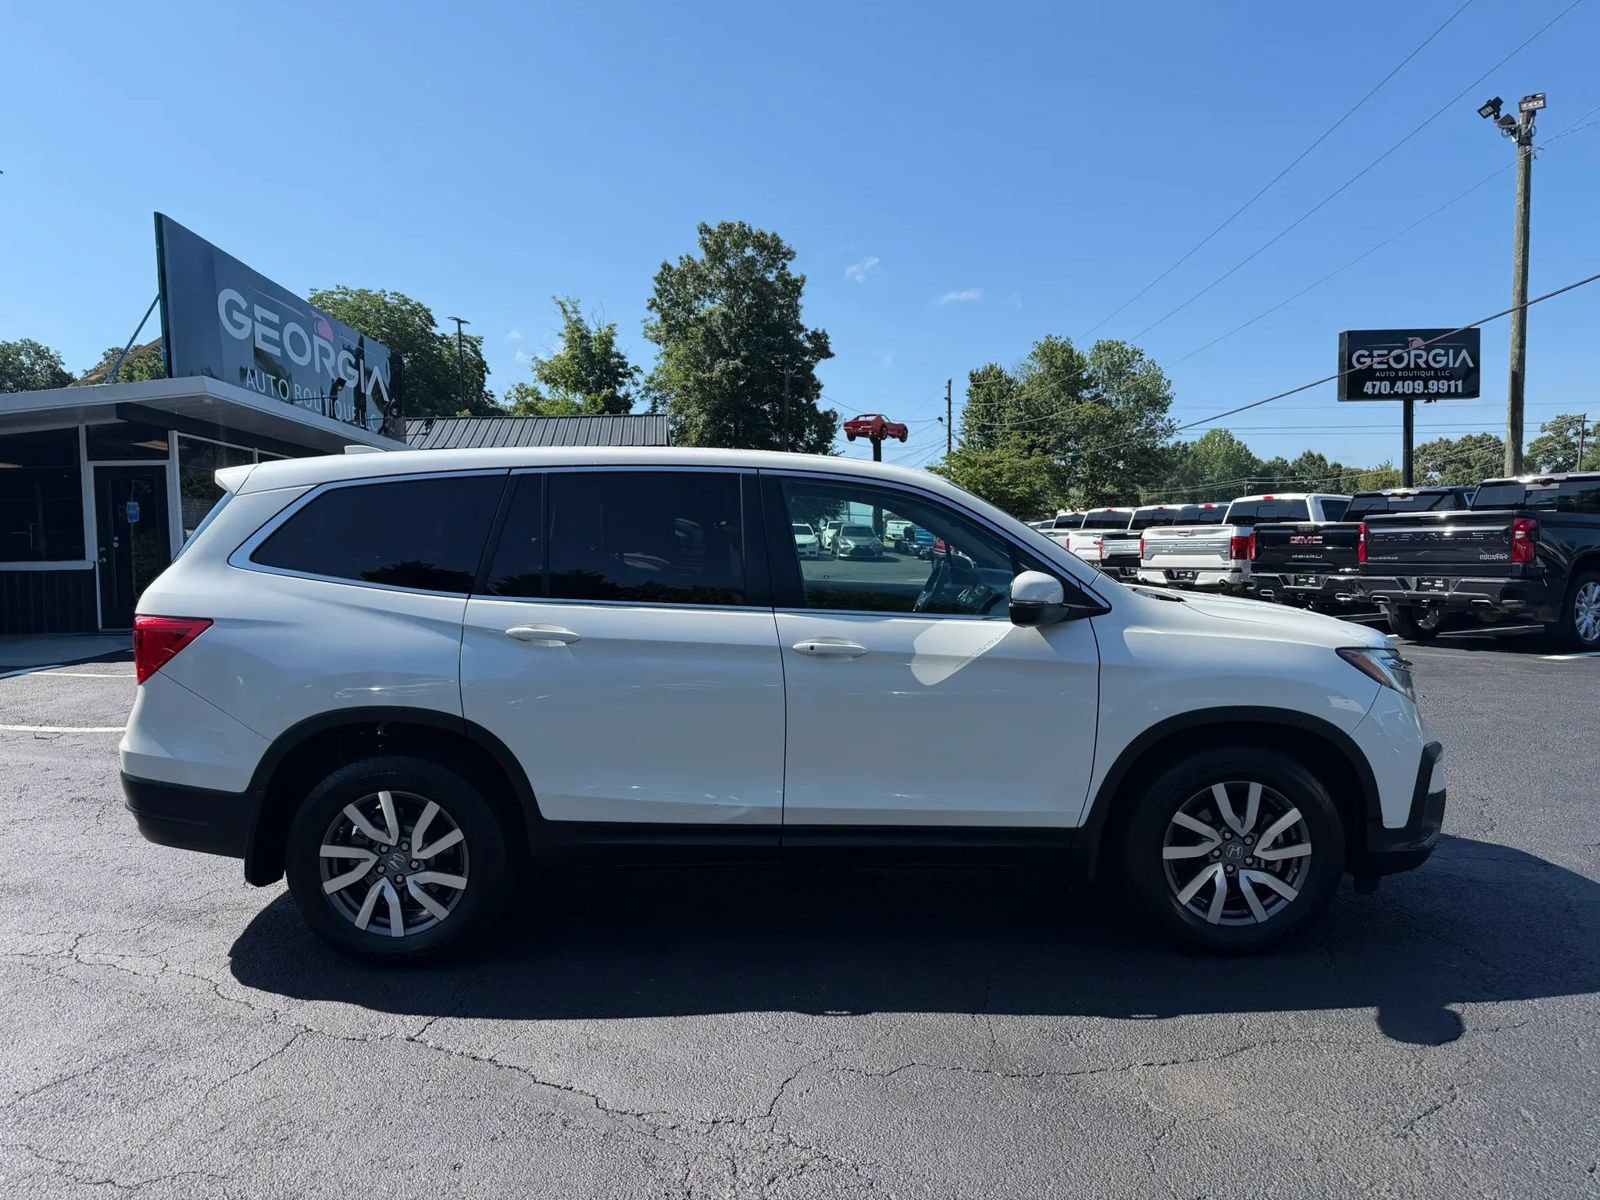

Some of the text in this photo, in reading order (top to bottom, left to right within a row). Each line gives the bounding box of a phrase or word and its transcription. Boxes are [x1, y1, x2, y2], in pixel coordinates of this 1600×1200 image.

[217, 288, 390, 403] GEORGIA
[1351, 348, 1475, 370] GEORGIA
[1398, 370, 1435, 378] BOUTIQUE
[1437, 369, 1451, 377] LLC
[246, 366, 290, 401] AUTO
[1363, 379, 1463, 395] 470.409.9911
[1289, 535, 1324, 545] GMC
